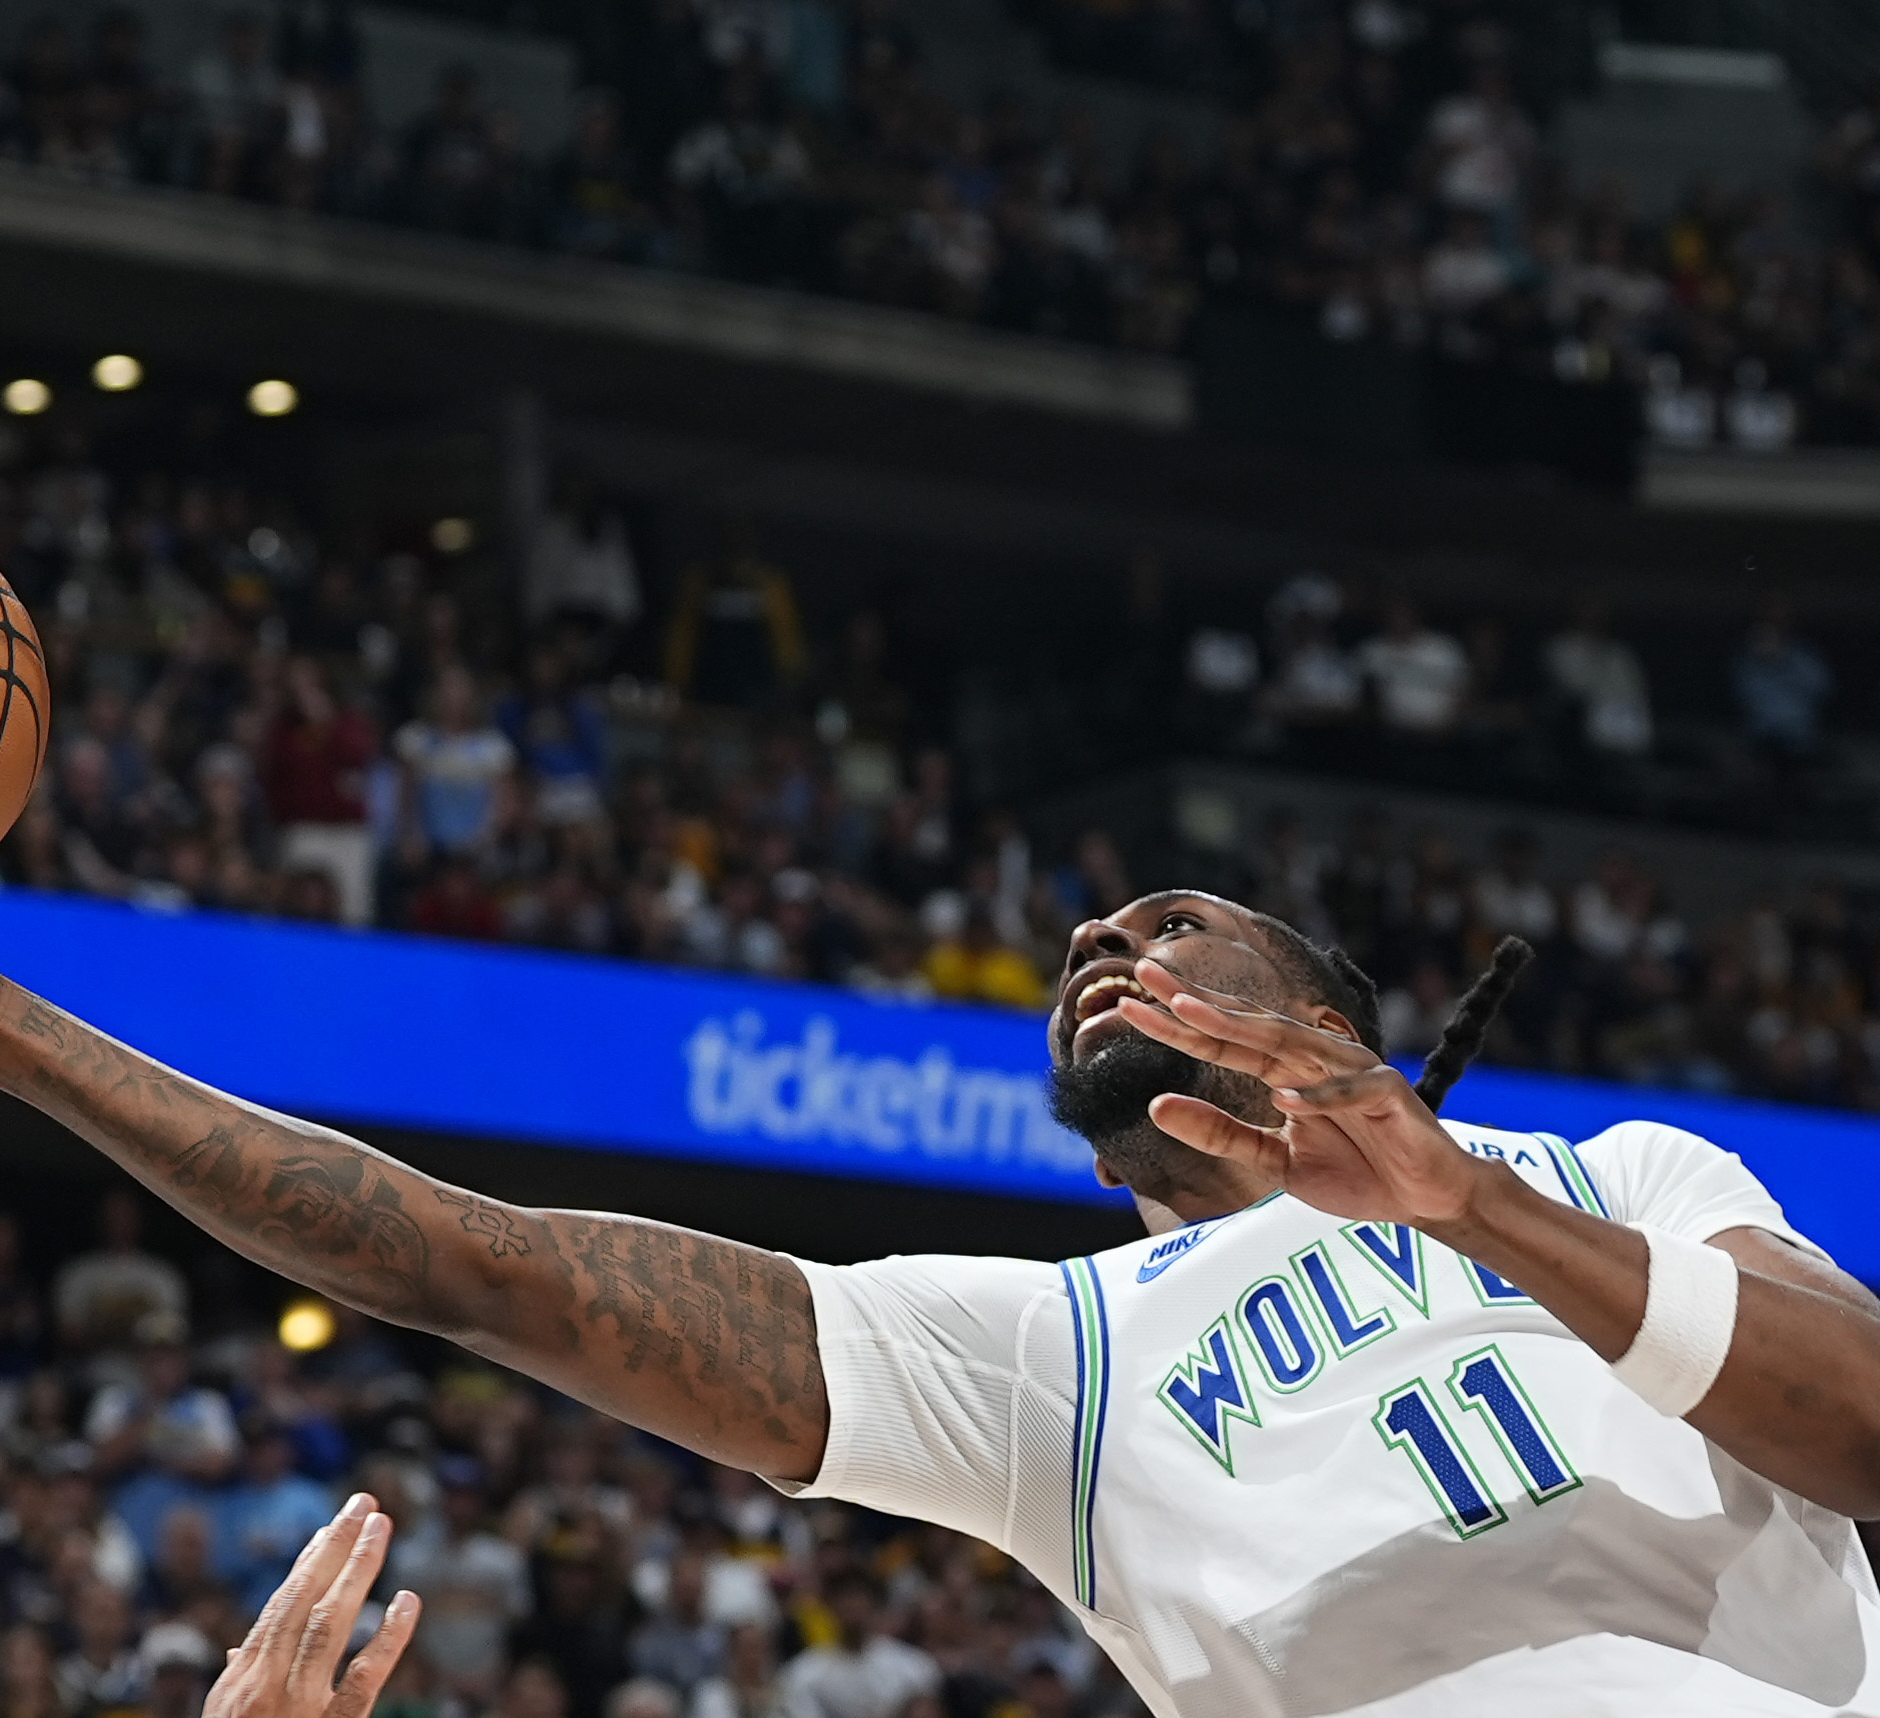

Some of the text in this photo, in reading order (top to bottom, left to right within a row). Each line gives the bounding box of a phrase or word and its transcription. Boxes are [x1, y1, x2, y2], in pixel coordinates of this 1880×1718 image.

[1148, 1224, 1207, 1264] NIKE
[1156, 1221, 1540, 1478] WOLV
[1371, 1343, 1584, 1541] 11
